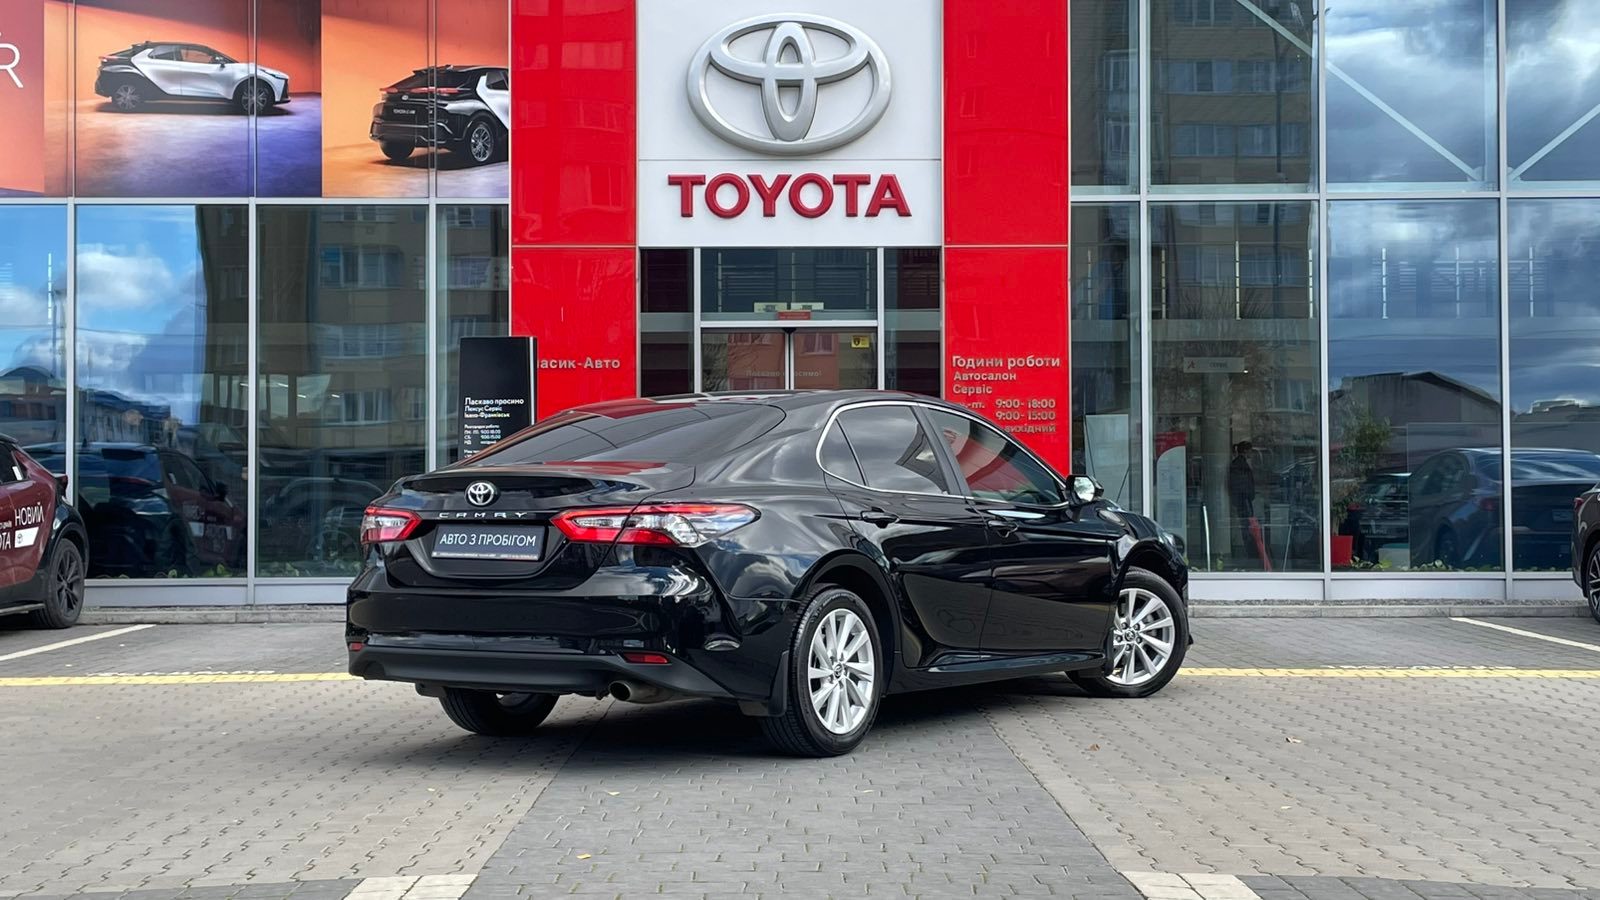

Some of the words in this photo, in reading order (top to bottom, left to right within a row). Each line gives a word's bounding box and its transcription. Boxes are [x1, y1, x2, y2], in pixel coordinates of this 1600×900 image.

[667, 172, 912, 219] TOYOTA
[537, 357, 621, 369] асик-Авто
[952, 355, 1003, 369] Години
[1008, 355, 1060, 370] роботи
[954, 371, 1016, 381] Автосалон
[953, 384, 993, 396] Сервіс
[465, 397, 493, 405] Ласкаво
[1028, 399, 1056, 409] 18:00
[1028, 411, 1056, 421] 15:00
[15, 502, 44, 526] НОВИЙ
[0, 532, 11, 550] TA
[439, 533, 467, 545] АВТО
[478, 534, 536, 547] ПРОБІГОМ
